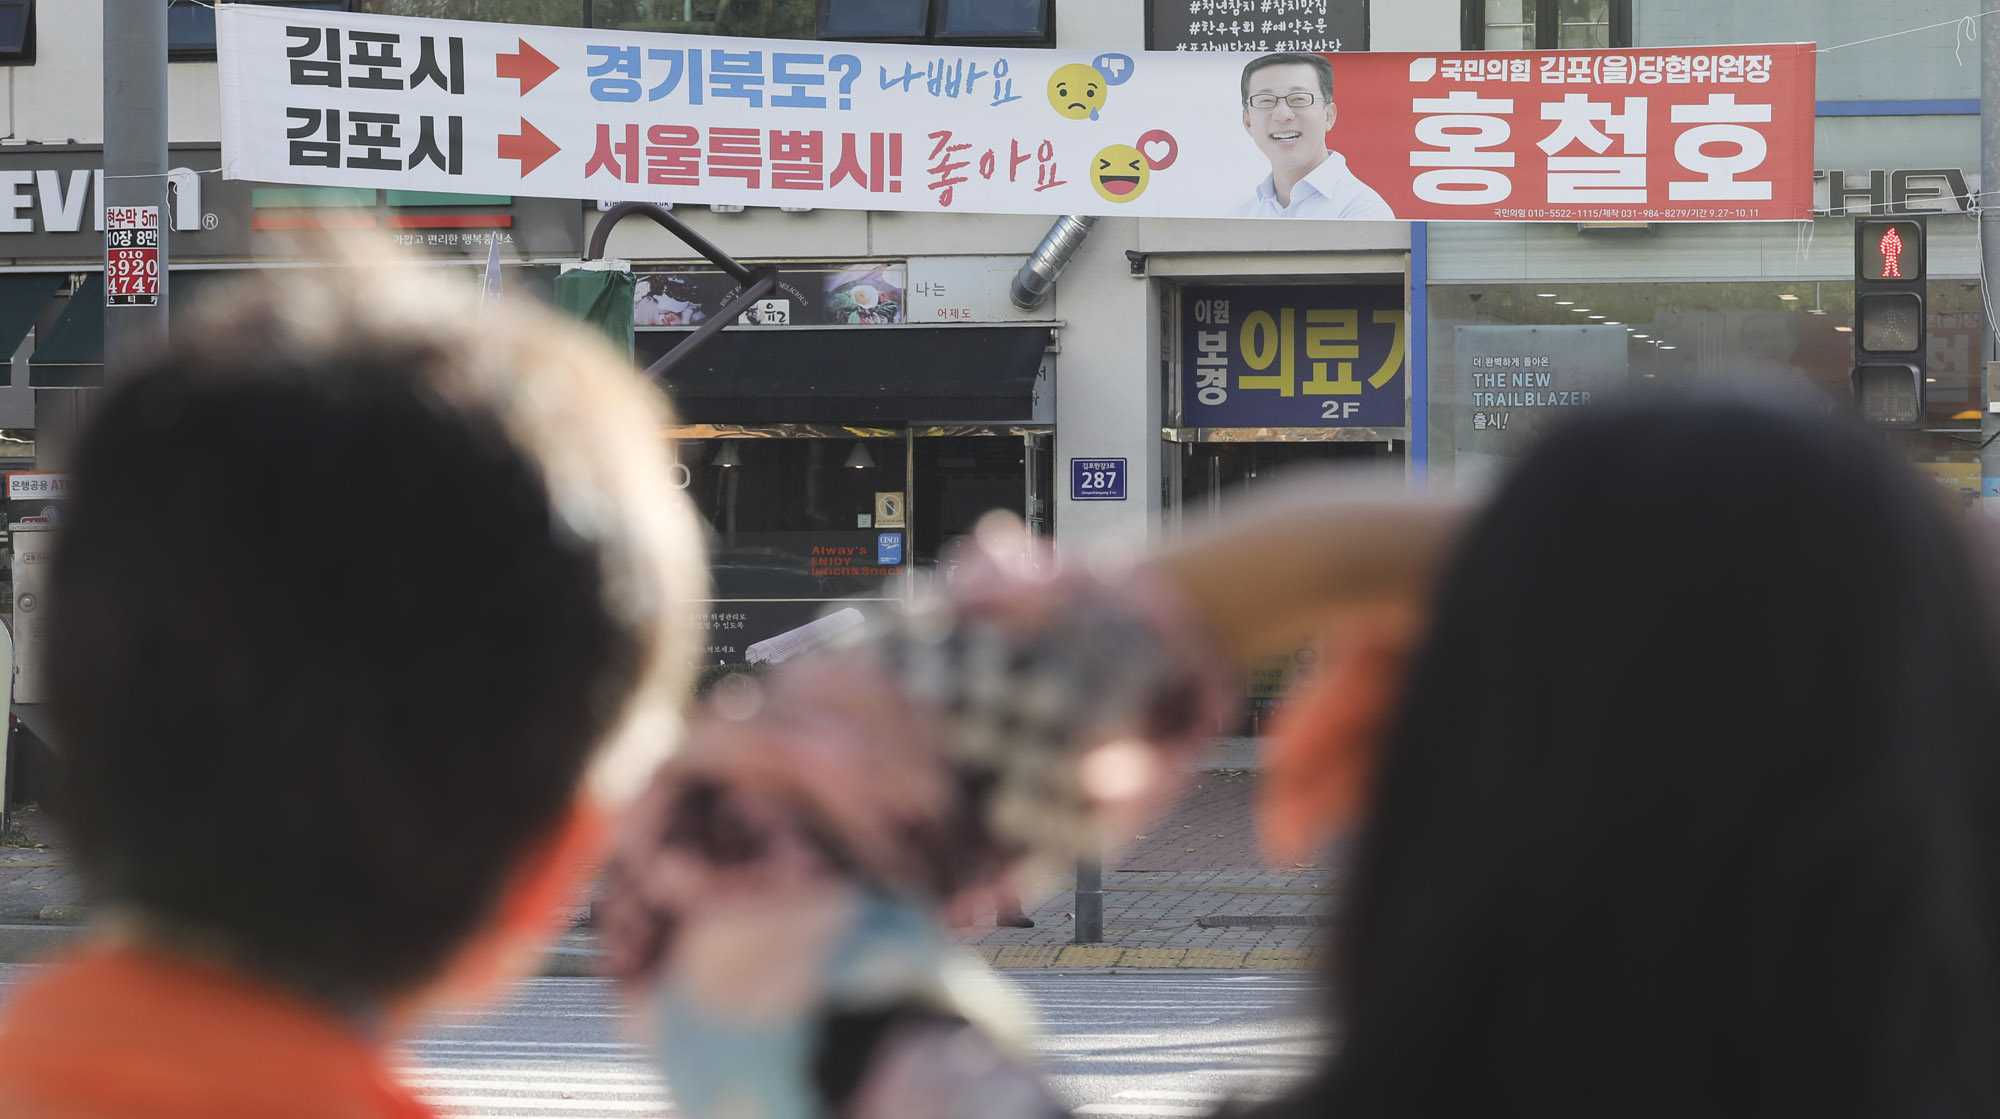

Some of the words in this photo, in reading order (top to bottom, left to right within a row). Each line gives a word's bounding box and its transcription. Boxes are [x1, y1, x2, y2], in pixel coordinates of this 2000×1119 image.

[1189, 0, 1255, 16] #청년참치
[1260, 0, 1328, 16] #참치맛집
[1189, 20, 1255, 36] #한우육회
[1261, 18, 1327, 35] #예약주문
[286, 26, 465, 95] 김포시
[586, 45, 861, 110] 경기북도?
[880, 58, 1023, 107] 나빠요
[1441, 59, 1531, 82] 국민의힘
[1539, 55, 1772, 84] 김포(을)당협위원장
[1409, 91, 1773, 205] 홍철호
[286, 107, 463, 175] 김포시
[585, 124, 902, 193] 서울특별시!
[927, 130, 1068, 207] 좋아요
[107, 209, 137, 228] 현수막
[141, 210, 158, 226] 5m
[1493, 208, 1526, 218] 국민의힘
[1709, 208, 1760, 218] 9.27~10.11
[107, 230, 133, 246] 10장
[136, 230, 158, 246] 8만
[427, 234, 458, 245] 편리한
[119, 251, 144, 259] 010
[107, 259, 158, 276] 5920
[107, 277, 159, 294] 4747
[916, 282, 946, 297] 나는
[937, 308, 971, 319] 어제도
[1195, 300, 1229, 324] 이원
[1473, 357, 1482, 367] 더
[1485, 357, 1520, 367] 완벽하게
[1523, 357, 1549, 367] 돌아온
[1473, 373, 1507, 387] THE
[1512, 373, 1551, 387] NEW
[1473, 392, 1592, 407] TRAILBLAZER
[1321, 400, 1360, 418] 2F
[1473, 413, 1509, 429] 출시!
[11, 480, 48, 491] 은행공용
[1081, 472, 1117, 488] 287
[812, 546, 867, 555] Alway's
[811, 557, 852, 566] ENJOY
